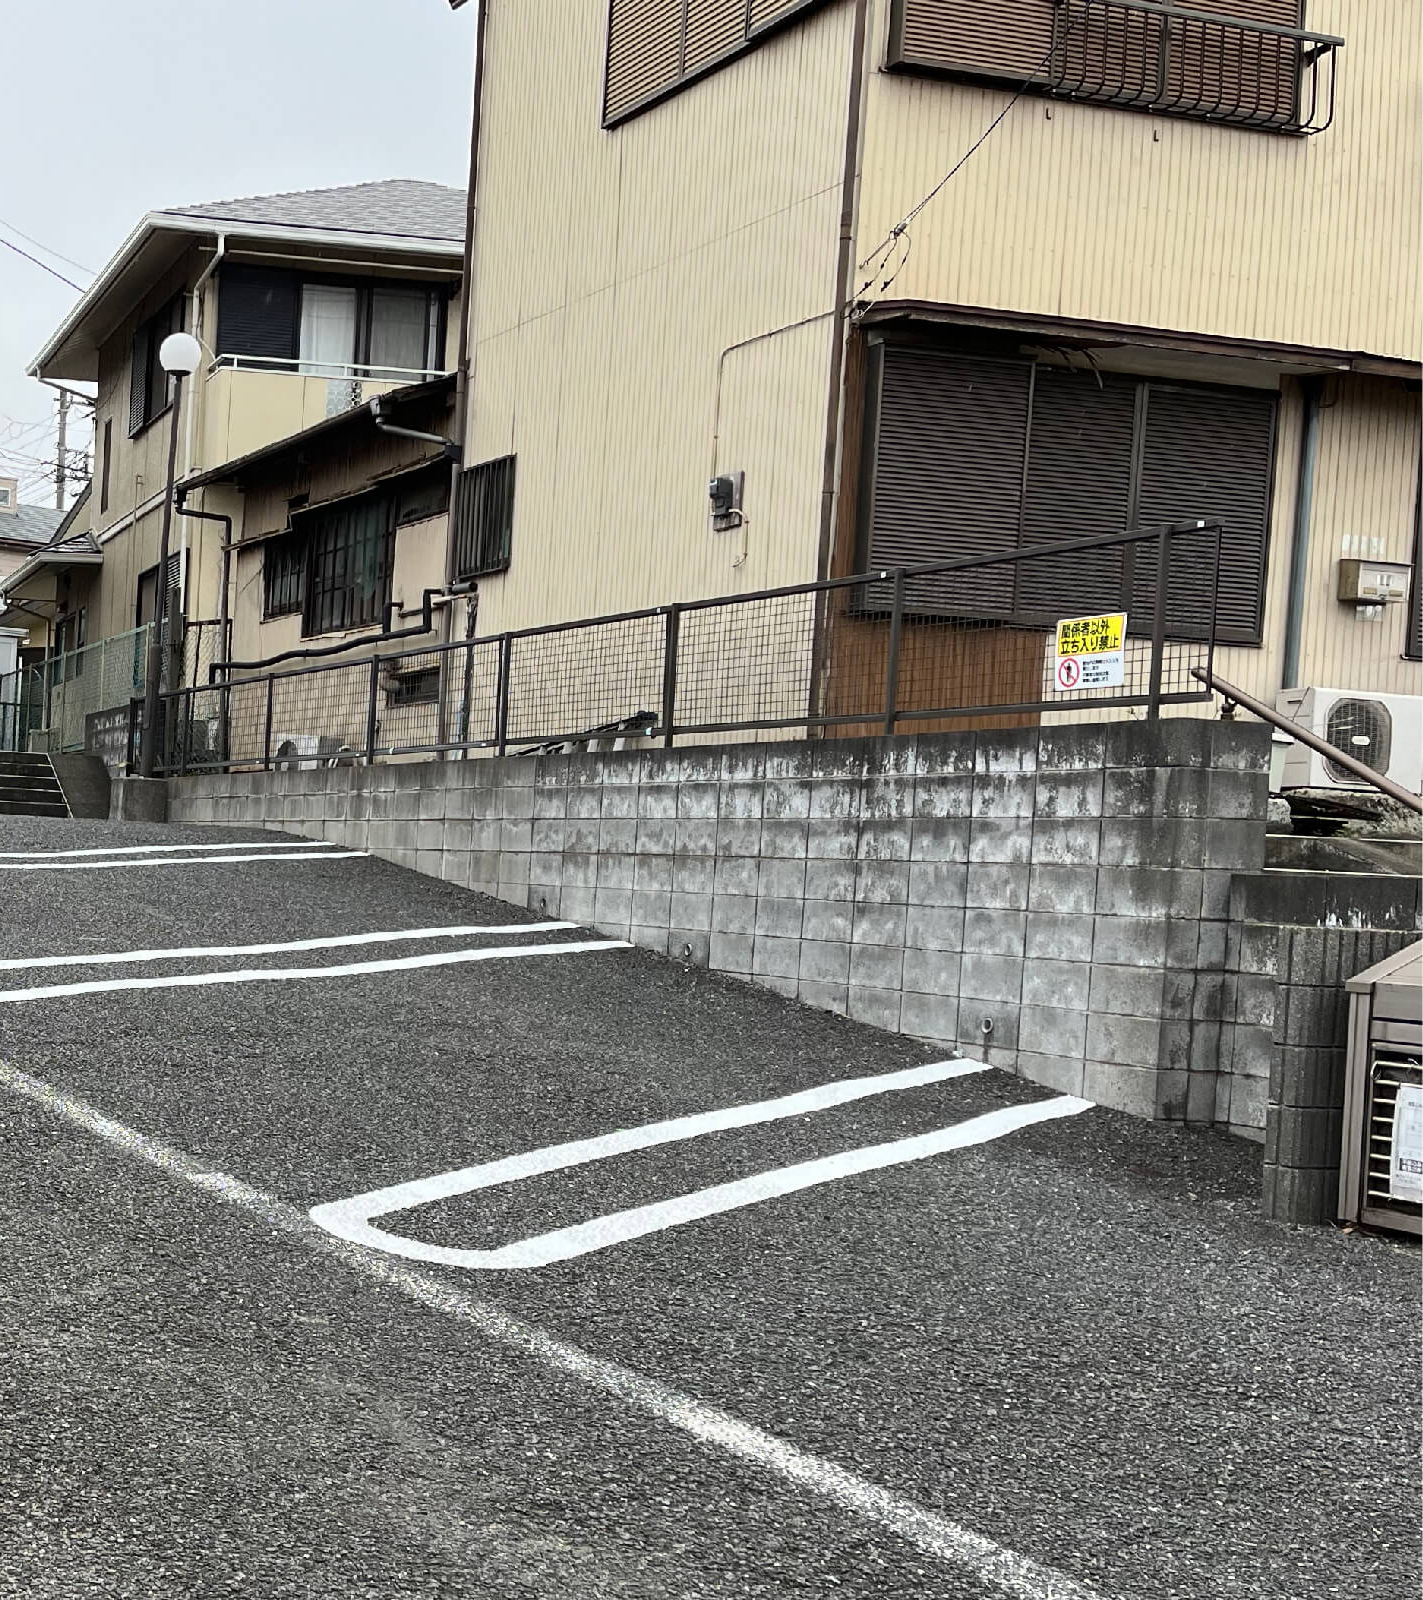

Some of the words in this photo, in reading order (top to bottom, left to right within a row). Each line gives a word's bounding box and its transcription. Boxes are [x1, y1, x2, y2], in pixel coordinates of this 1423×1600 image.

[1062, 619, 1110, 638] 関係者以外
[1061, 634, 1119, 654] 立ち入り禁止
